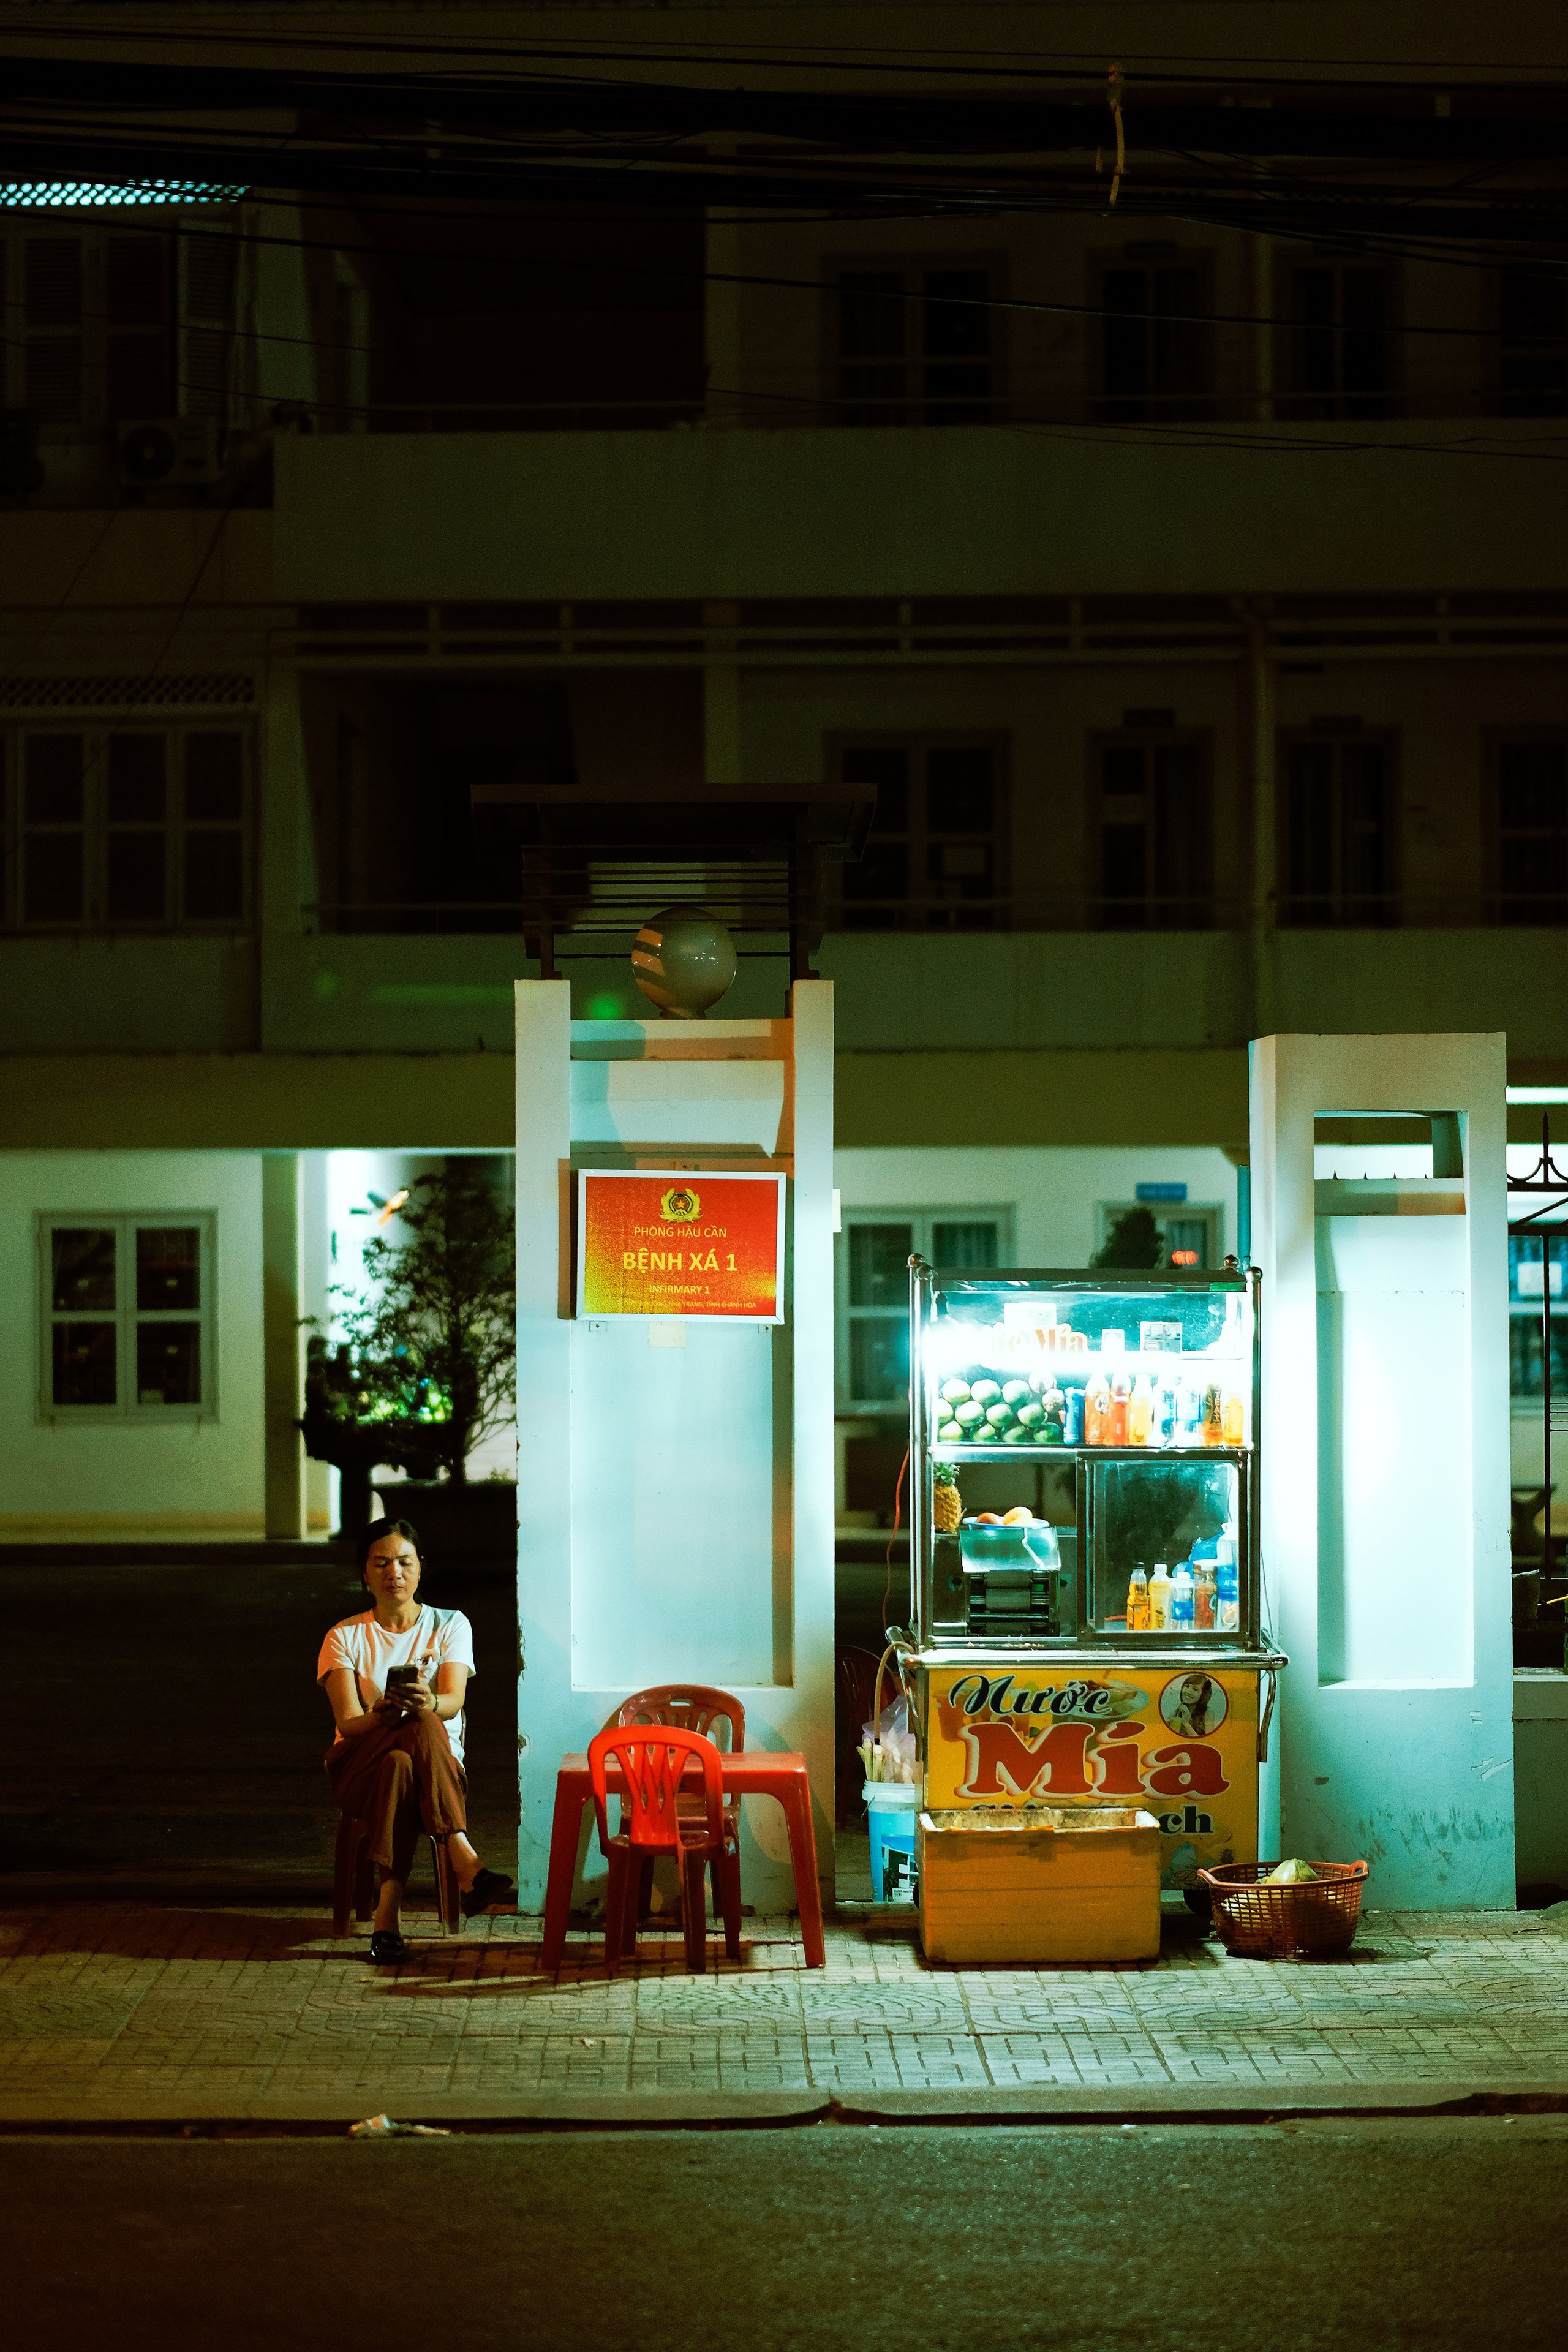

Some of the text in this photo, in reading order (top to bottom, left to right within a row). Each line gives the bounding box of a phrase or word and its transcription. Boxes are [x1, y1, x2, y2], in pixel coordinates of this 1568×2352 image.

[635, 1224, 674, 1237] PHÒNG
[704, 1224, 727, 1238] CẦN
[623, 1247, 738, 1274] BỆNH XÁ 1
[649, 1285, 710, 1294] INFIRMARY 1
[950, 1674, 1112, 1714] Nước
[954, 1720, 1229, 1800] Mía
